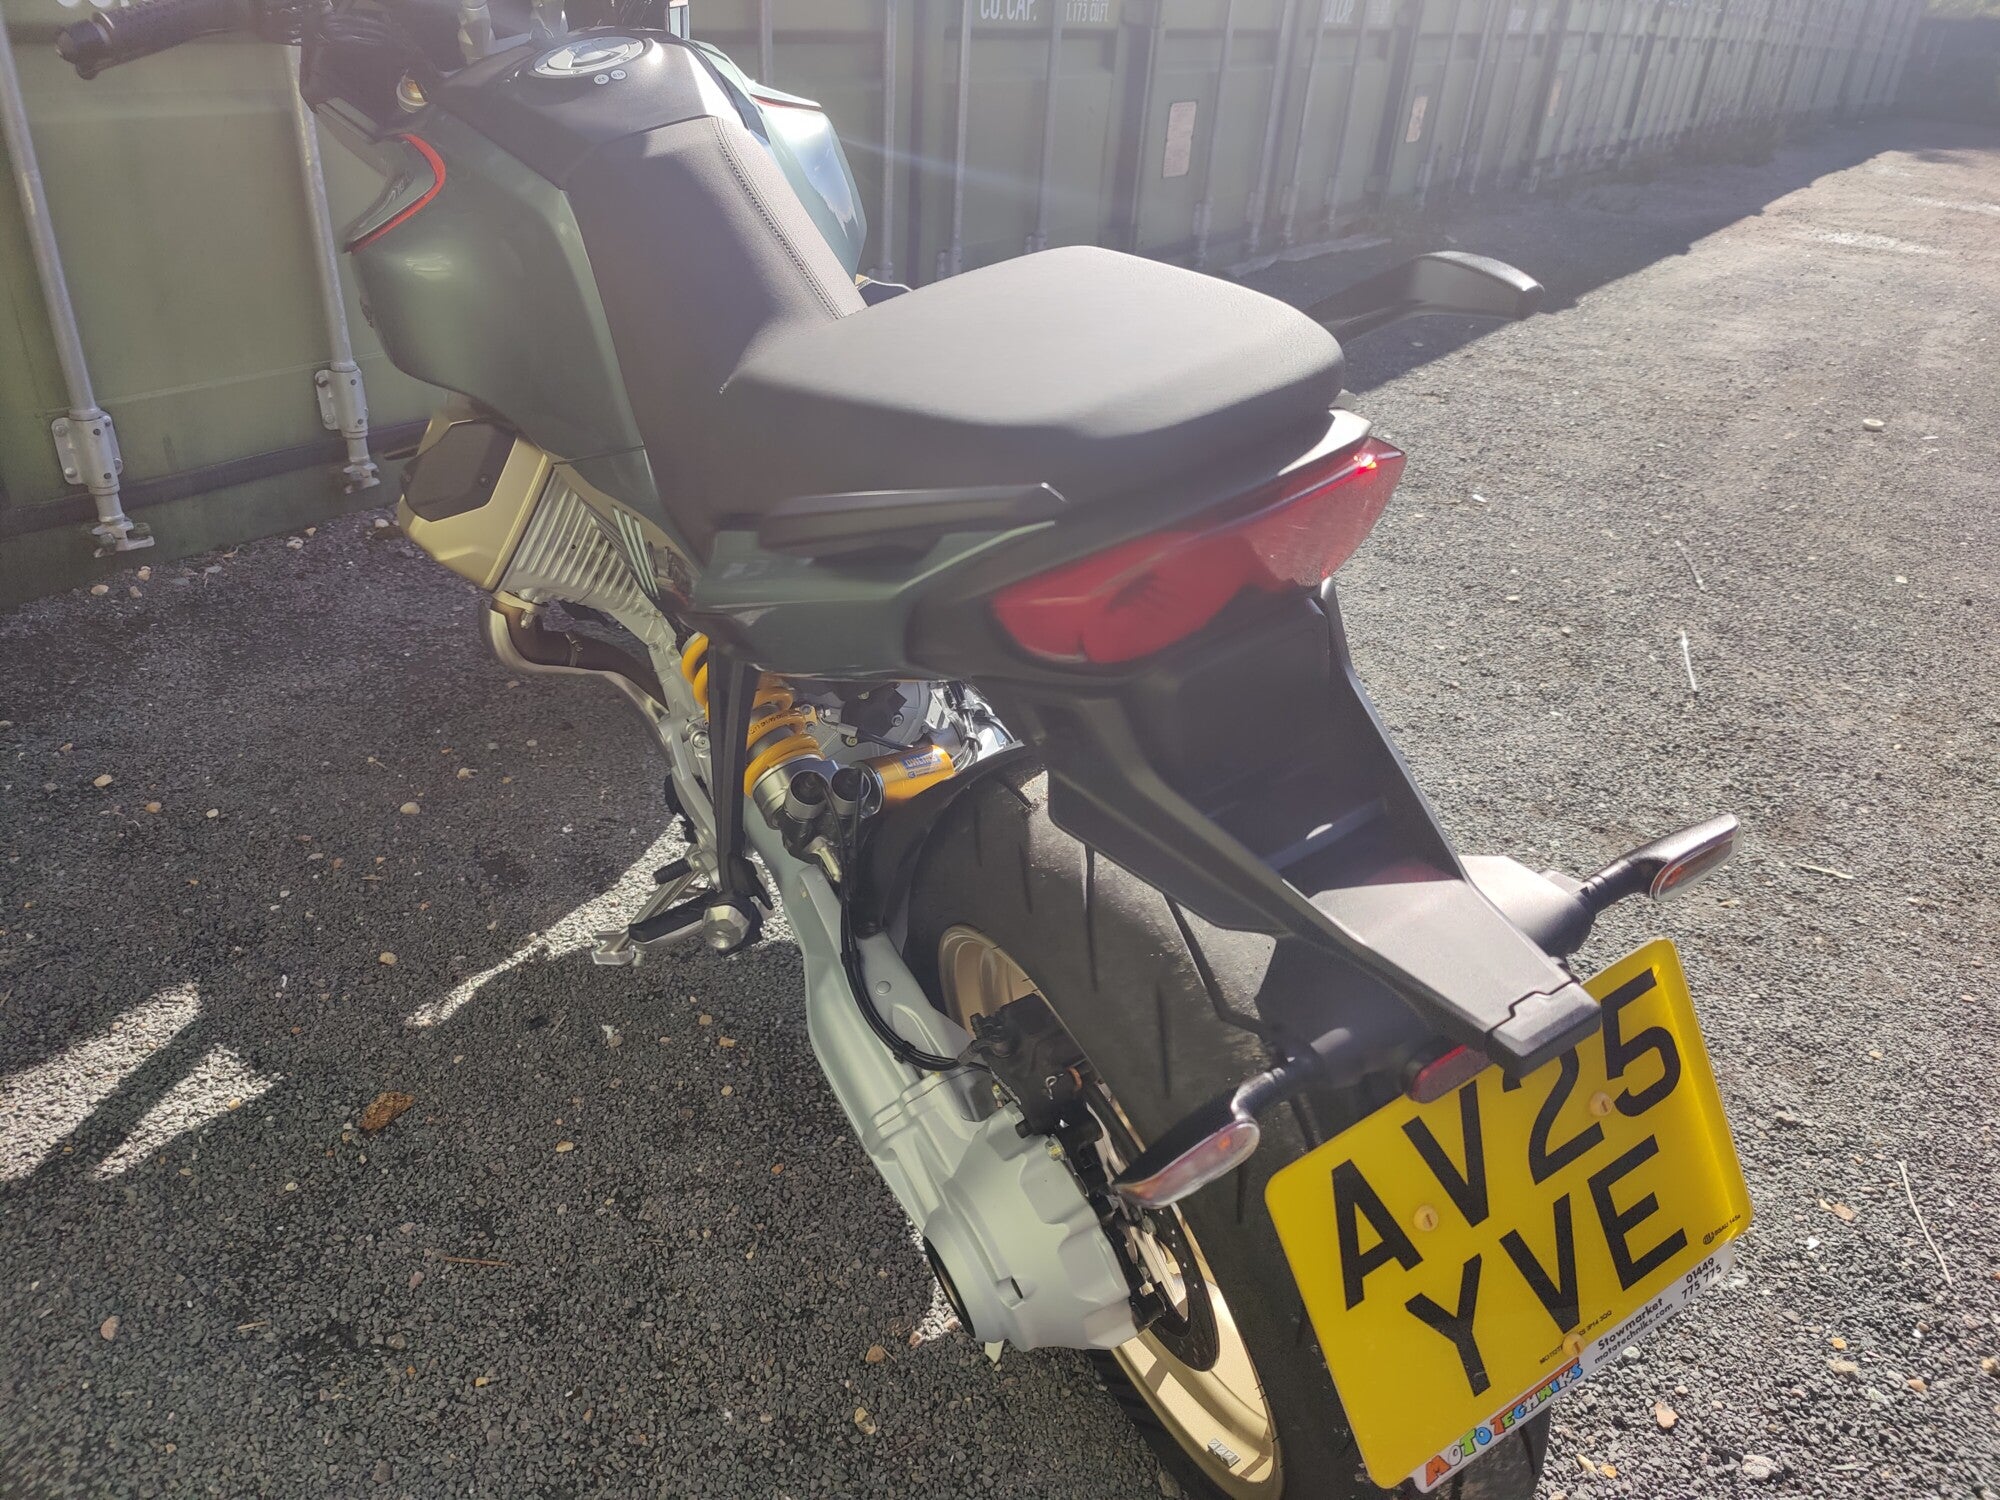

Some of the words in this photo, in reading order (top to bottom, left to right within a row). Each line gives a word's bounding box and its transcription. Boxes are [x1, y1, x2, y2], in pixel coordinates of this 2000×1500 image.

[1331, 967, 1681, 1311] AV25
[1405, 1133, 1688, 1398] YVE
[1681, 1280, 1701, 1300] 775
[1703, 1263, 1722, 1282] 775
[1686, 1257, 1715, 1284] 01449
[1594, 1302, 1674, 1364] mototechniks.com
[1597, 1297, 1664, 1351] Stowmarket
[1425, 1426, 1492, 1487] MOTO
[1490, 1357, 1583, 1436] TECHNIKS
